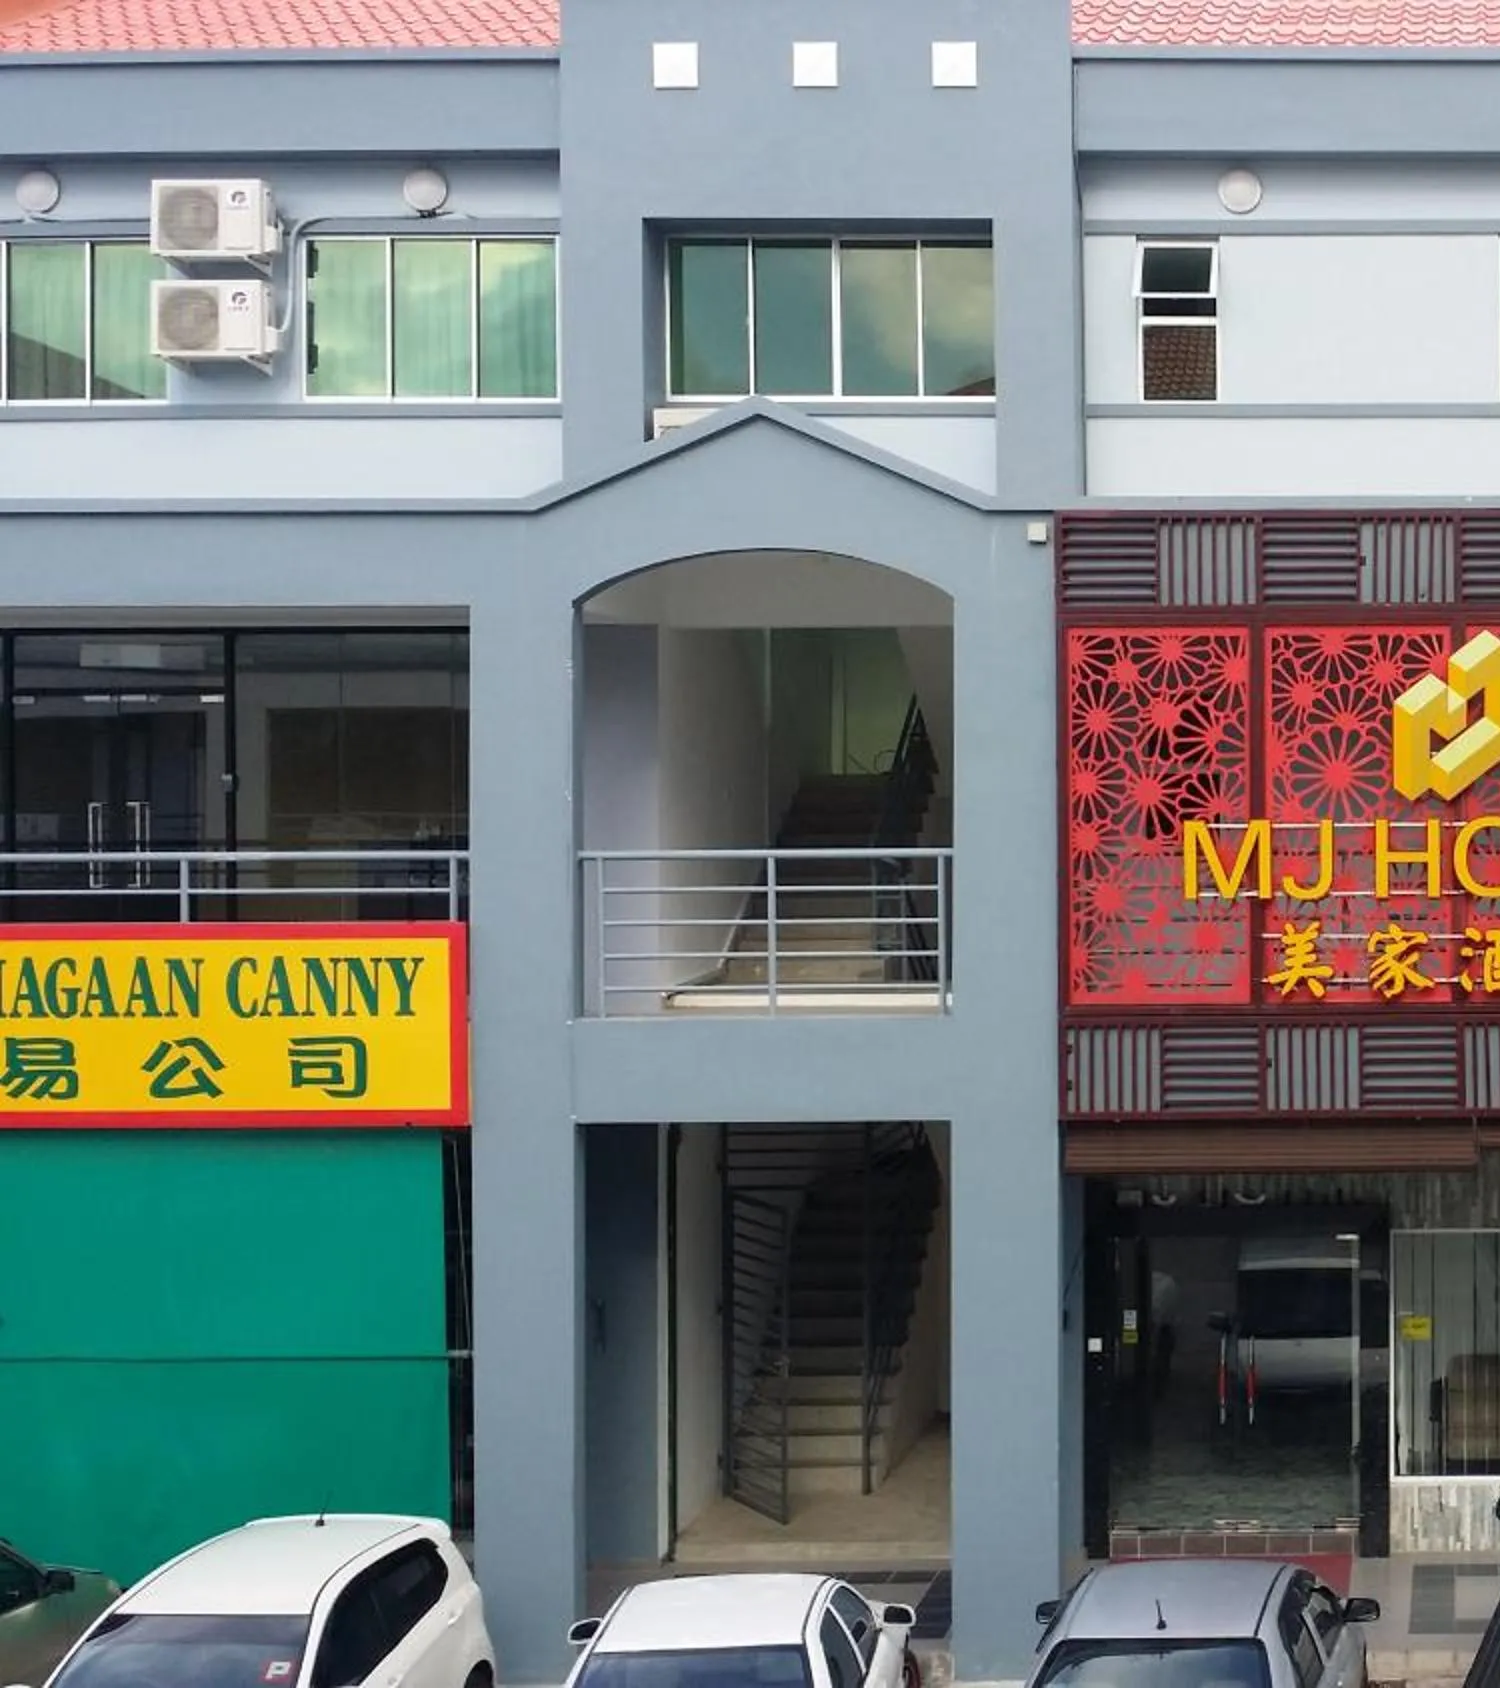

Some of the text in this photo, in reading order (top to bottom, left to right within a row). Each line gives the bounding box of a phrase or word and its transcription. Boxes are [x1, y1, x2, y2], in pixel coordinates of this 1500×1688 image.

[1182, 818, 1335, 900] MJ
[225, 956, 424, 1019] CANNY
[0, 1035, 368, 1099] 易公司
[264, 1661, 292, 1680] P
